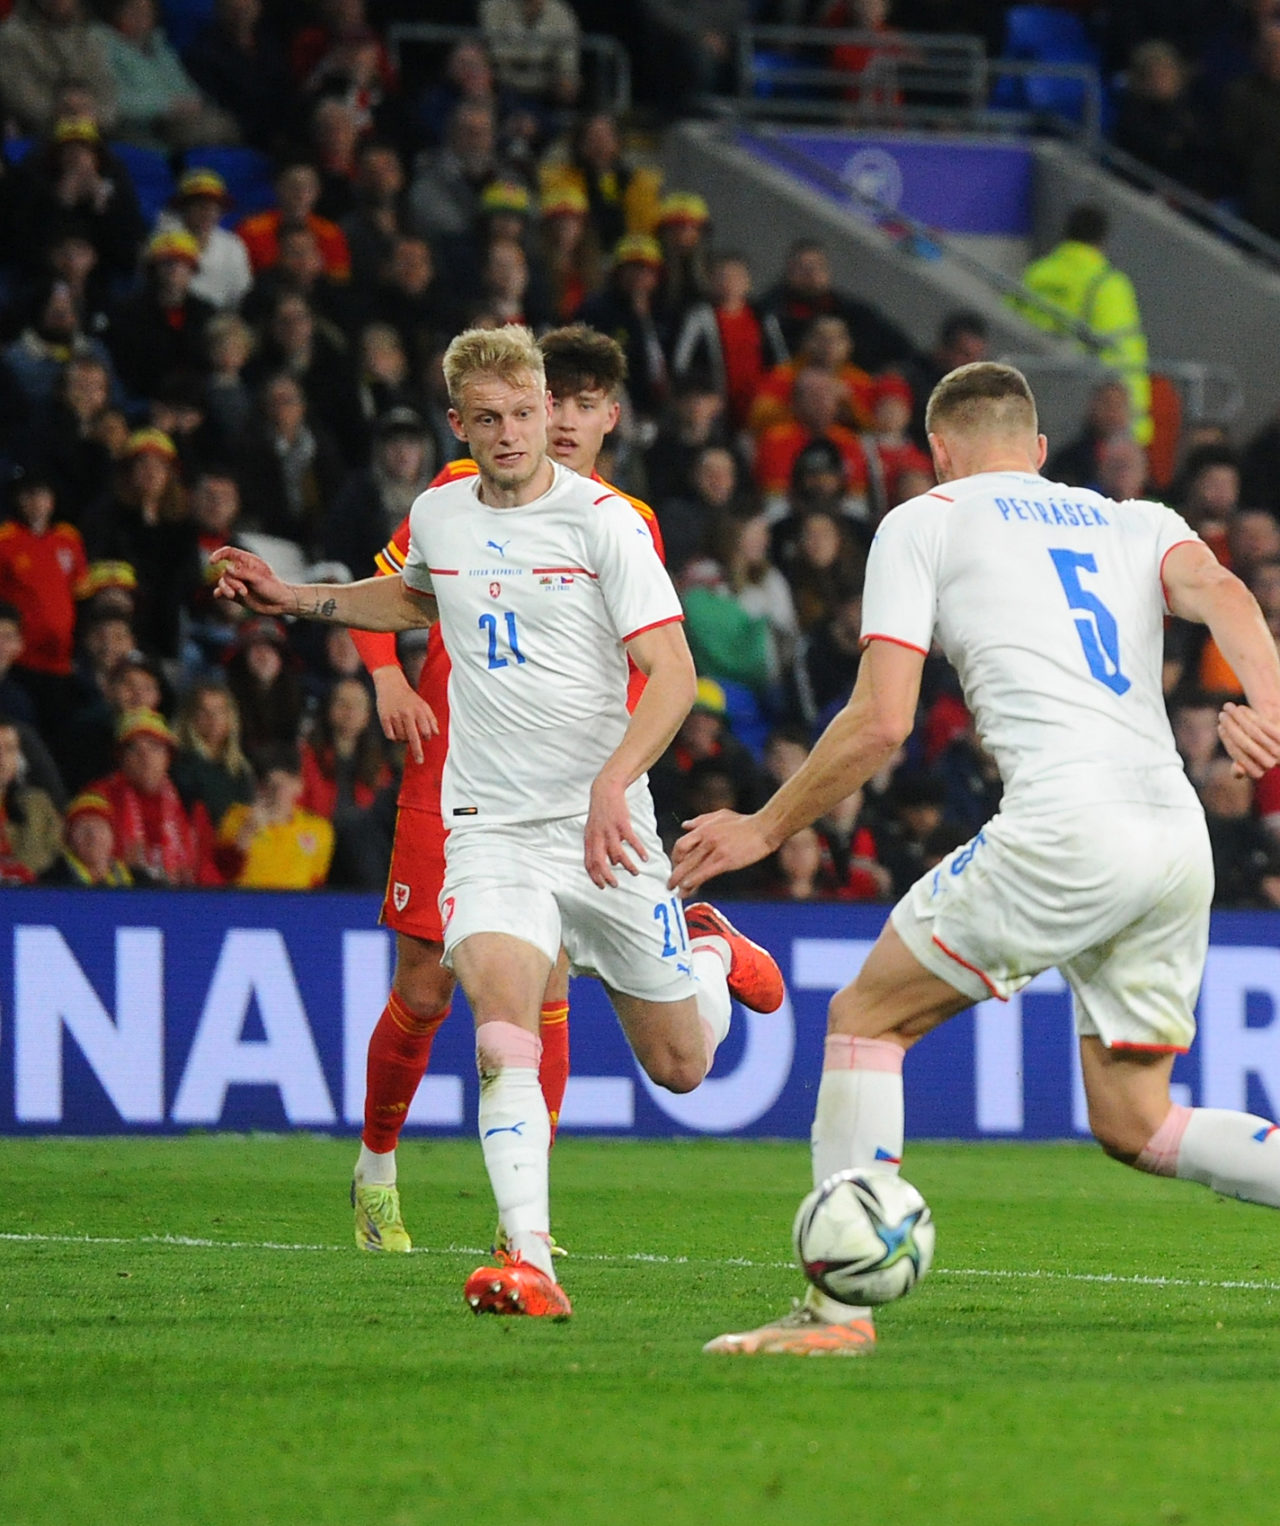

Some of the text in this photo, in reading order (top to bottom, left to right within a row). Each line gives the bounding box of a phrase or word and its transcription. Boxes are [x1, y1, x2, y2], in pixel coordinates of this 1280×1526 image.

[994, 497, 1110, 527] PETRÁŠEK
[478, 611, 526, 670] 21
[1047, 548, 1132, 696] 5
[653, 897, 687, 958] 21
